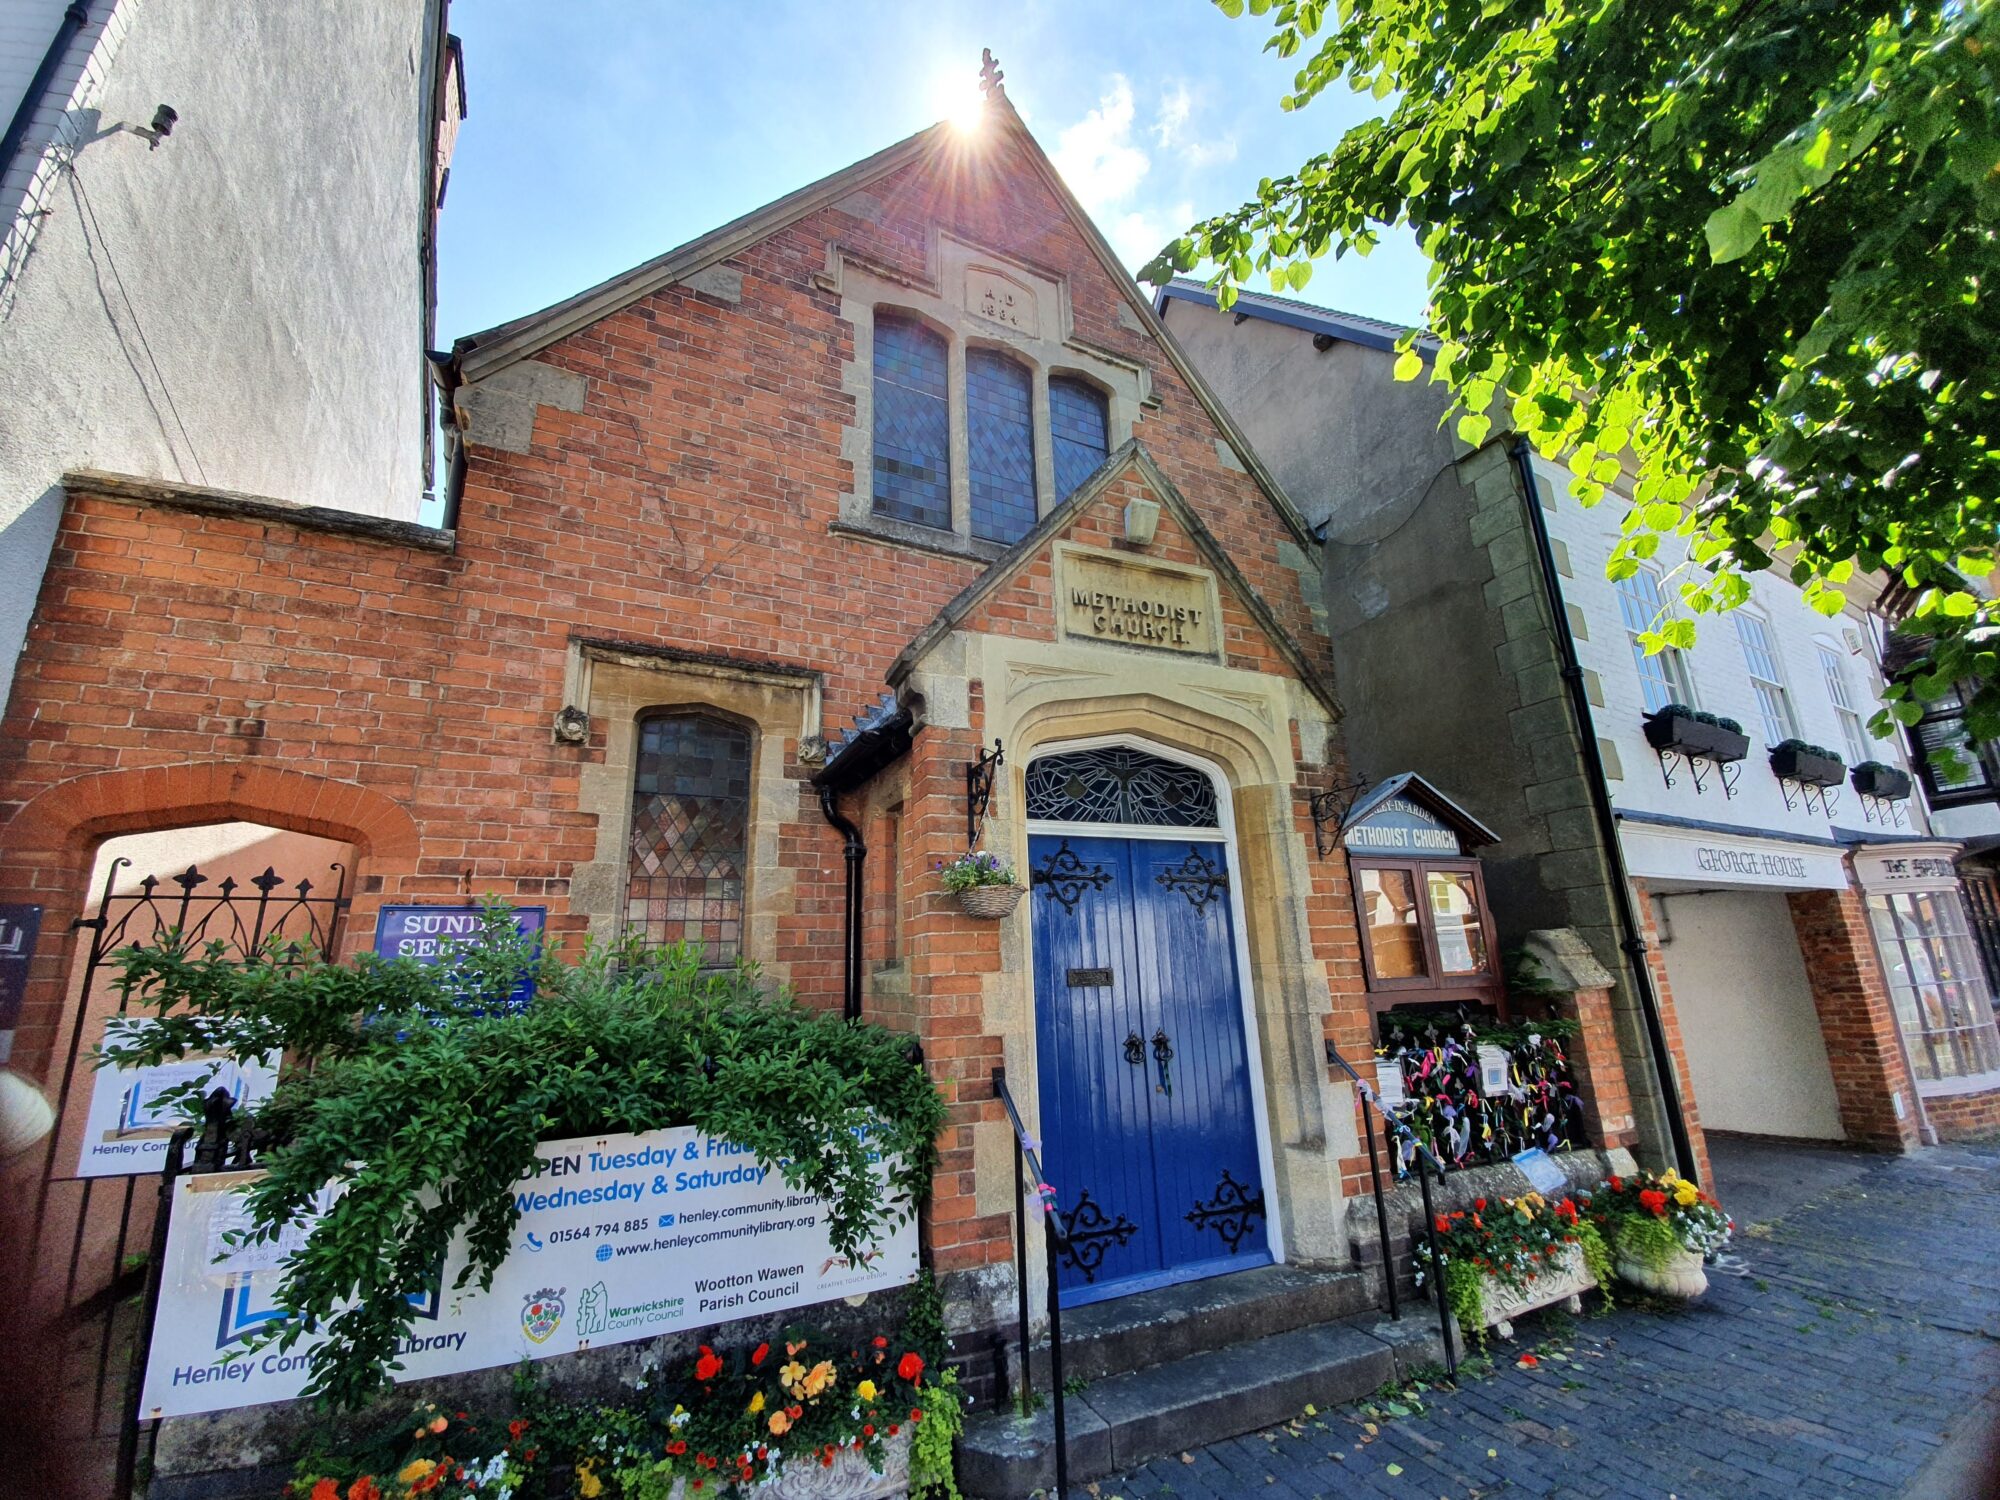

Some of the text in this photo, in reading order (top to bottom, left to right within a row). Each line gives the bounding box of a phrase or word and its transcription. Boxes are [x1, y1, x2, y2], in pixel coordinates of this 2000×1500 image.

[1072, 587, 1202, 624] METHODIST
[1362, 799, 1437, 825] LEY-IN-ARDEN
[1344, 825, 1457, 849] METHODIST CHURCH
[1697, 847, 1807, 878] GEORGE HOUSE
[403, 915, 522, 934] SUND
[92, 1143, 138, 1156] Henley
[518, 1138, 755, 1181] OPEN Tuesday & Frida
[512, 1164, 766, 1213] Wednesday & Saturday
[550, 1226, 591, 1244] 01564
[595, 1222, 620, 1237] 794
[624, 1218, 649, 1233] 885
[616, 1215, 815, 1257] www.henleycommunitylibrary.org
[695, 1264, 804, 1293] Wootton Wawen
[609, 1297, 684, 1318] Warwickshire
[699, 1281, 799, 1312] Parish Council
[608, 1307, 684, 1330] County Council
[393, 1331, 467, 1356] Library
[172, 1361, 256, 1387] Henley
